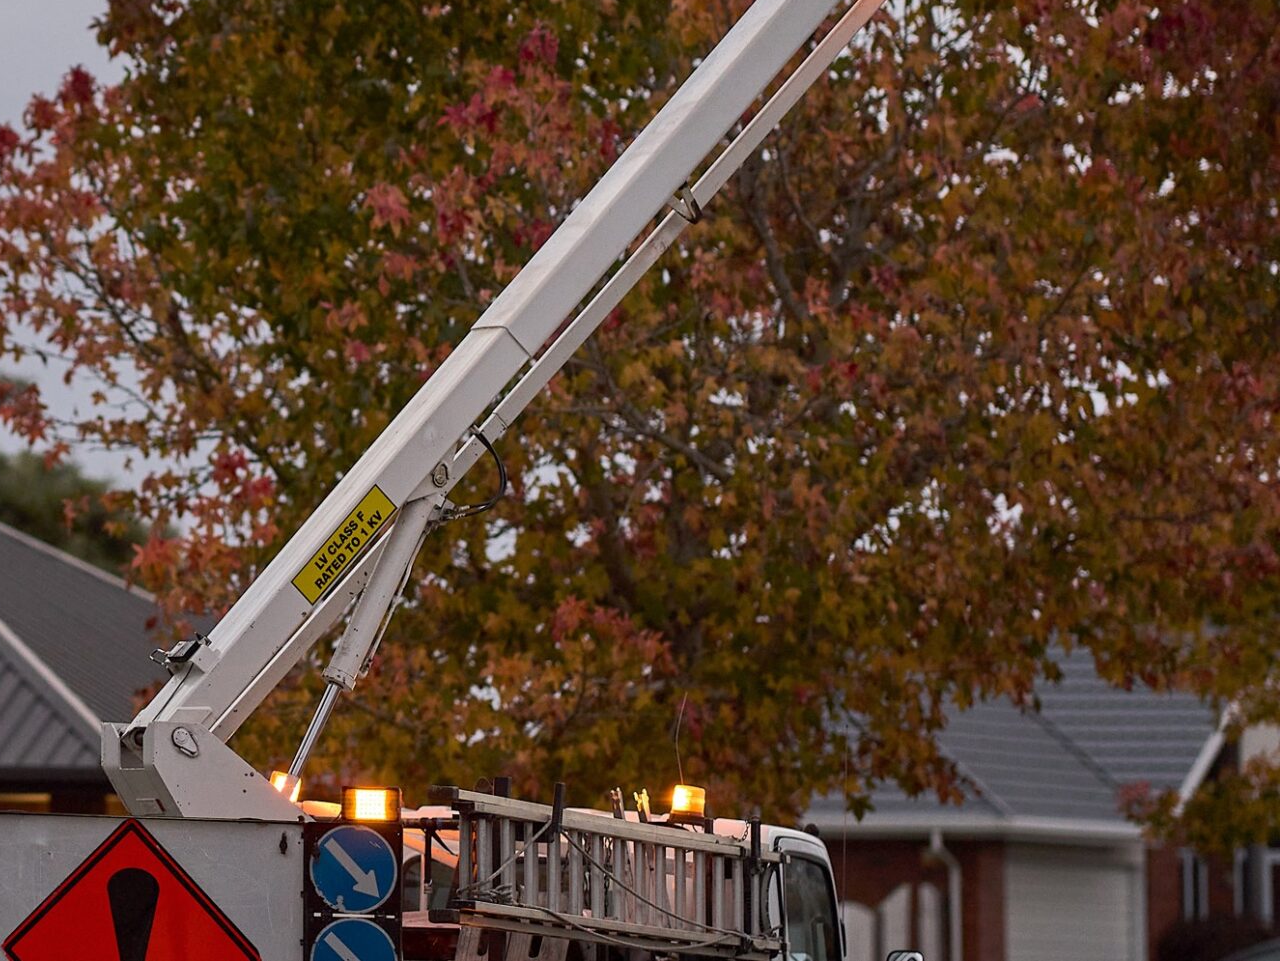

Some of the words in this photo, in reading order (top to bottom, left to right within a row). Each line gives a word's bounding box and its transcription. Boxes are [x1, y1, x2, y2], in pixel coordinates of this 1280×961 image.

[314, 553, 328, 570] LV
[327, 520, 358, 555] CLASS
[356, 511, 364, 521] F
[314, 553, 347, 589] RATED
[344, 537, 361, 553] TO
[360, 528, 368, 536] 1
[367, 510, 383, 529] KV
